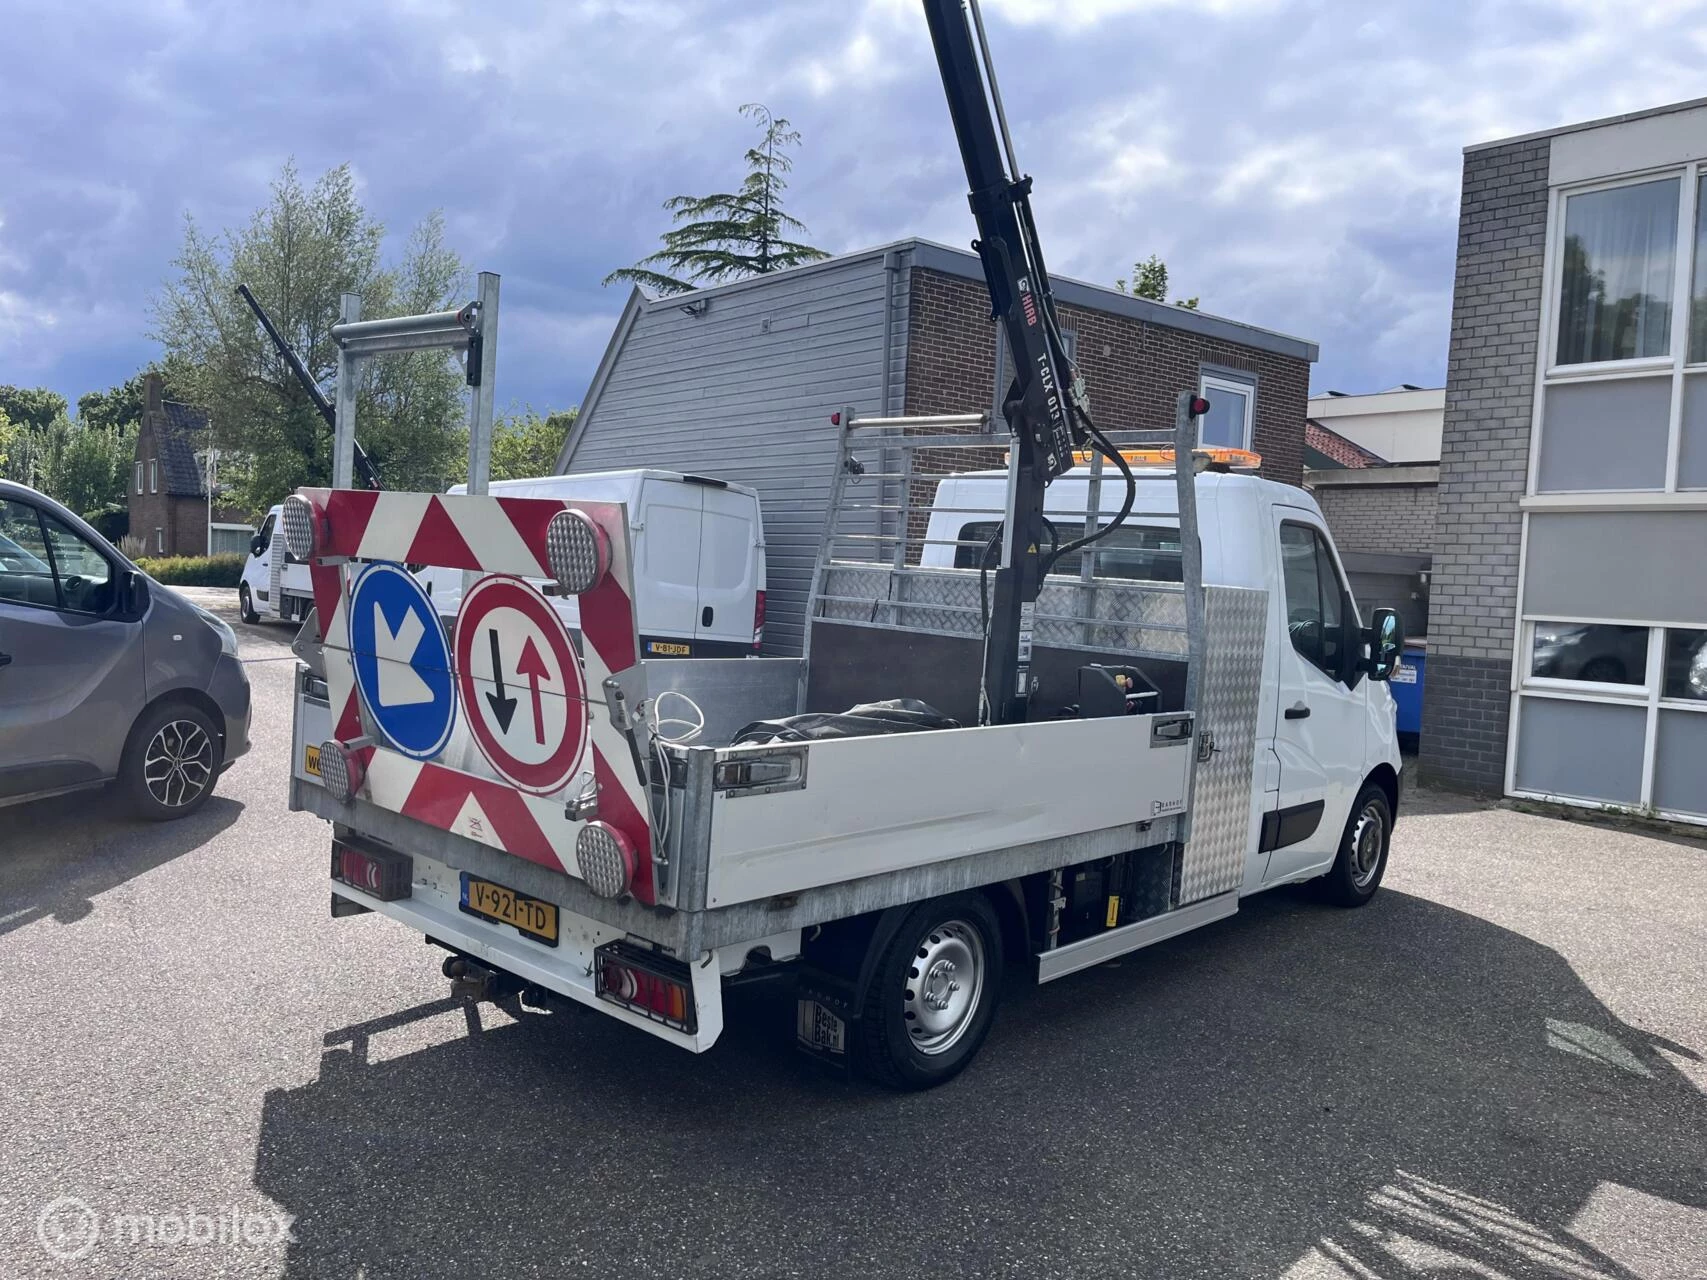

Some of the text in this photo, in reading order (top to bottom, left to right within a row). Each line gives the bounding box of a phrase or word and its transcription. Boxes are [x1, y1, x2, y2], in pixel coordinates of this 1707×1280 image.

[1022, 293, 1037, 326] HIAB
[1037, 353, 1060, 421] T-CLX 013
[475, 883, 546, 930] V-921-TD
[815, 1005, 838, 1033] Beste
